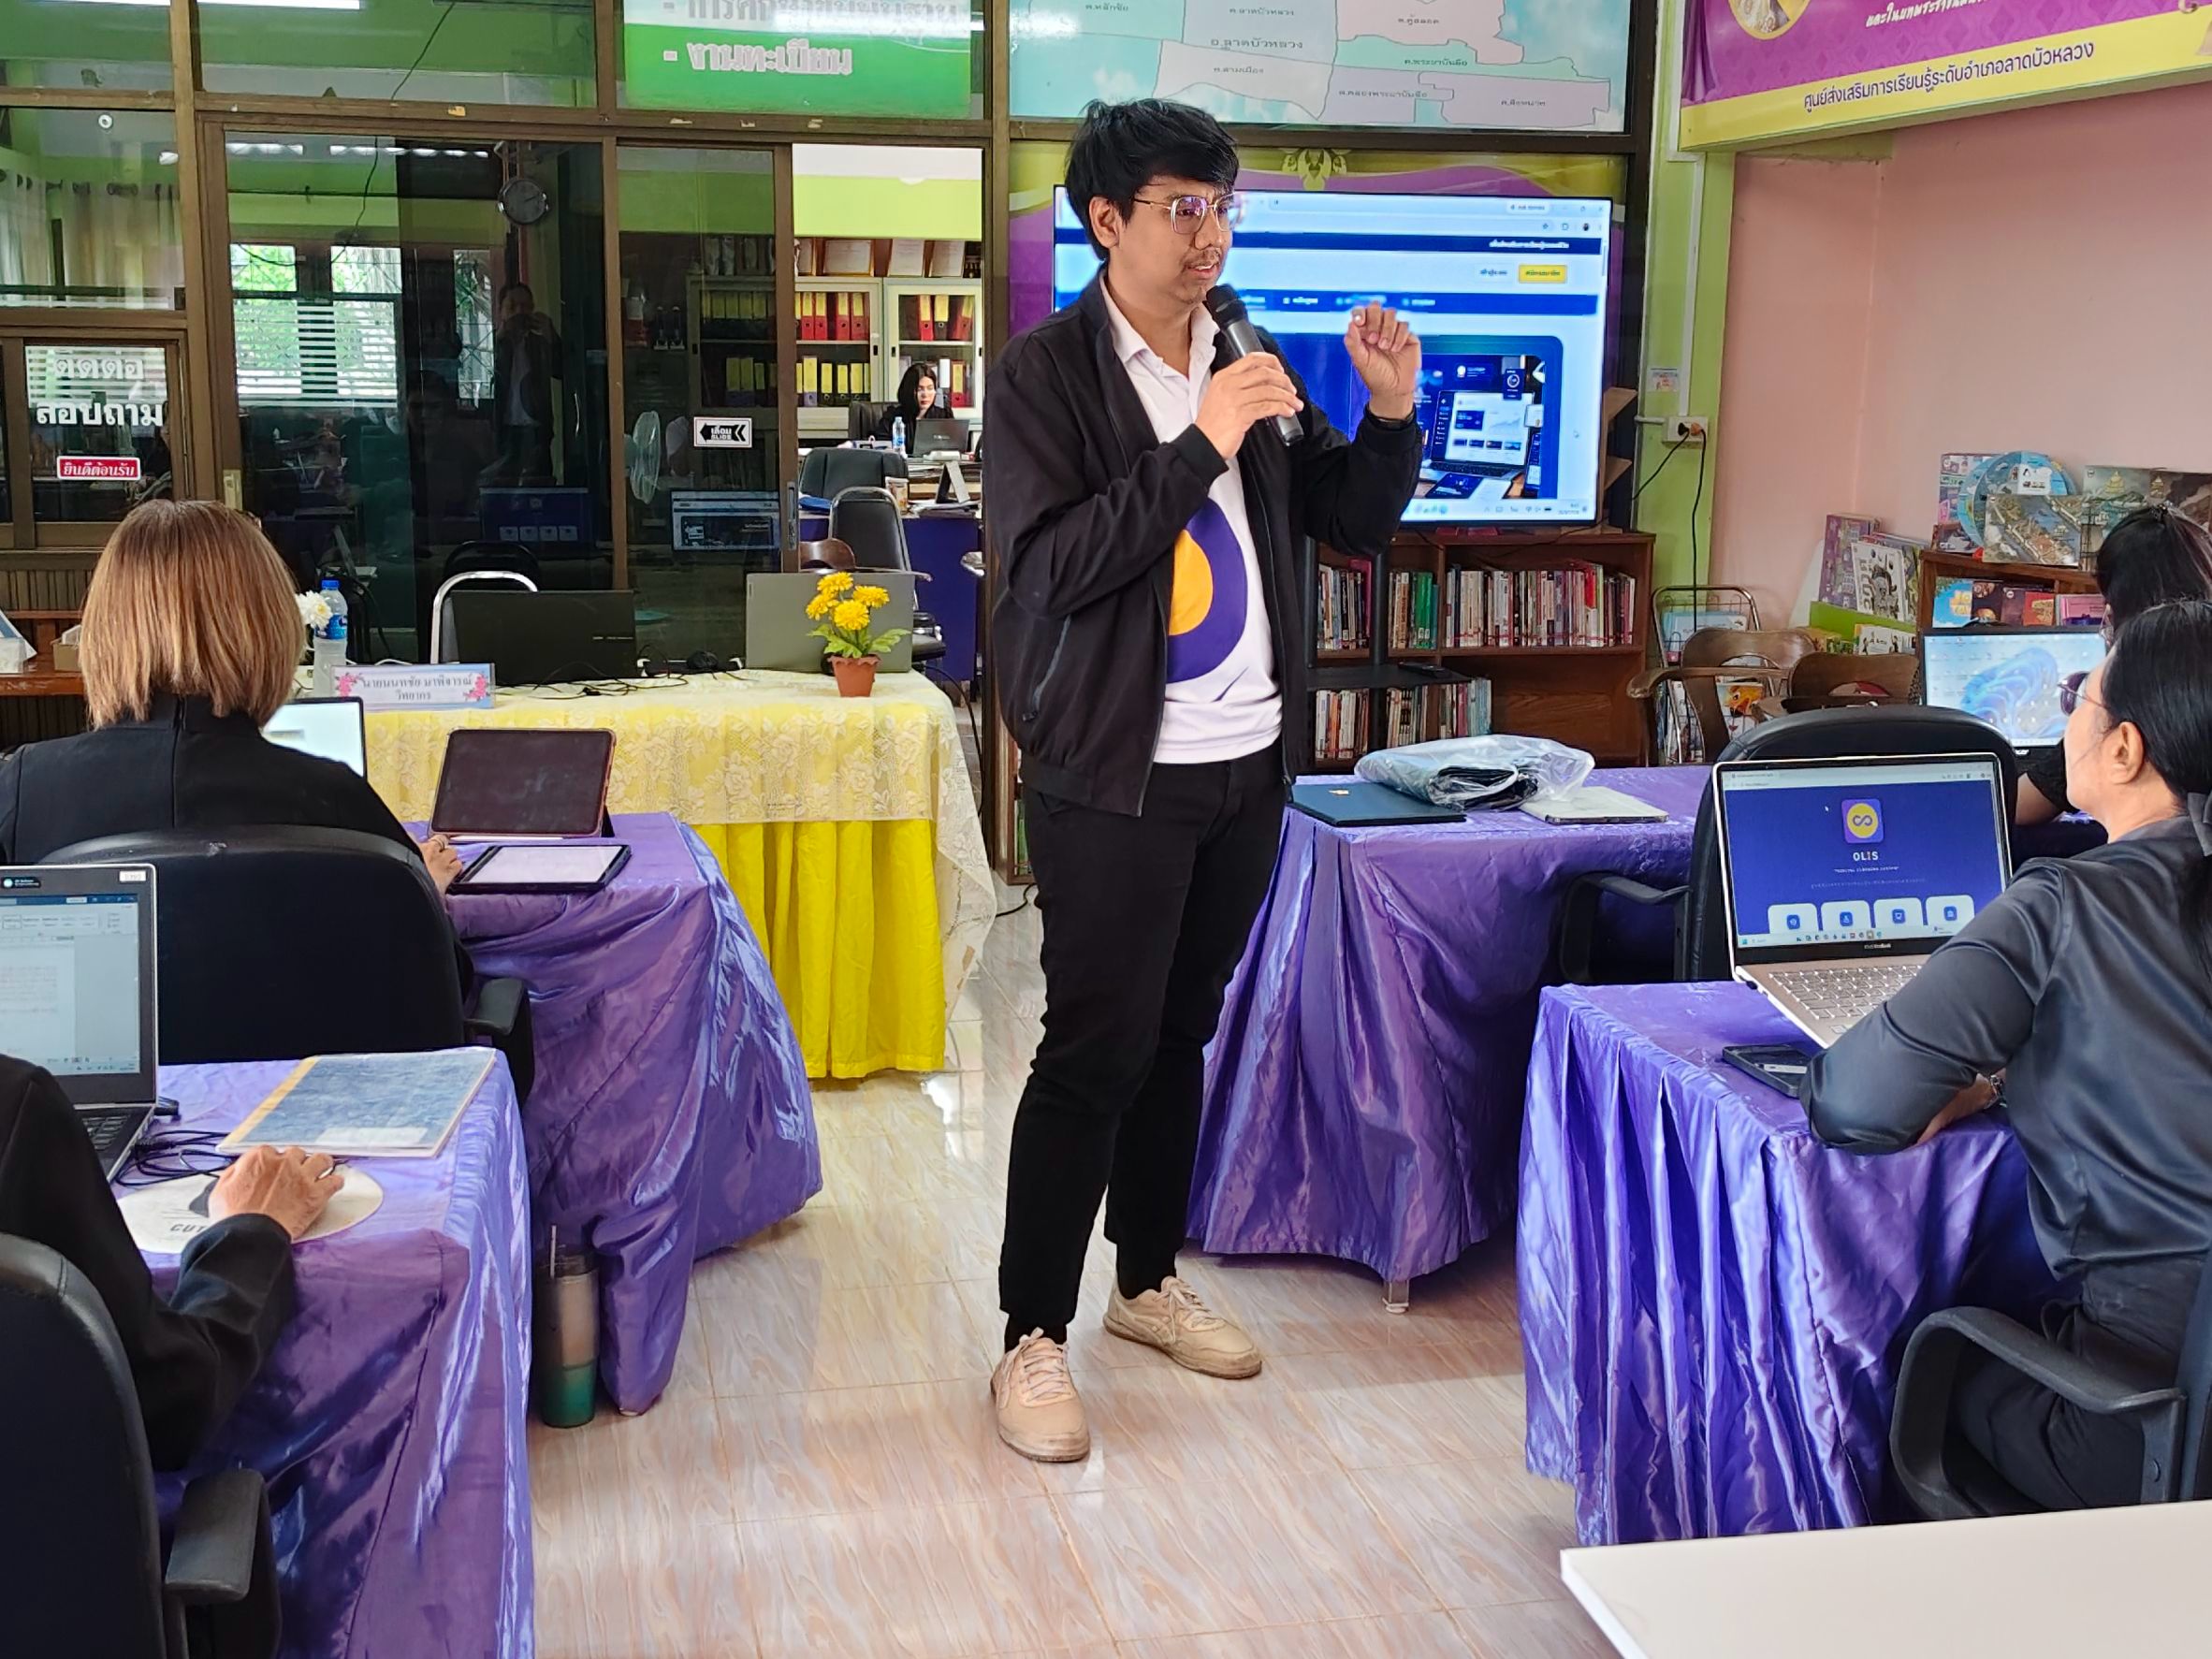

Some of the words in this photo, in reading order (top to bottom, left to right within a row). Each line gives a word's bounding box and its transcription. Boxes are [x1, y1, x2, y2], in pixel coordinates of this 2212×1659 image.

[1210, 36, 1303, 50] อ.ลาดบัวหลวง
[686, 37, 853, 76] งานทะเบียน
[1803, 40, 2095, 113] ศูนย์ส่งเสริมการเรียนรู้ระดับอำเภอลาดบัวหลวง
[36, 401, 164, 427] สอบถาม
[63, 461, 136, 477] ยินดีต้อนรับ
[396, 689, 431, 701] วิทยากร
